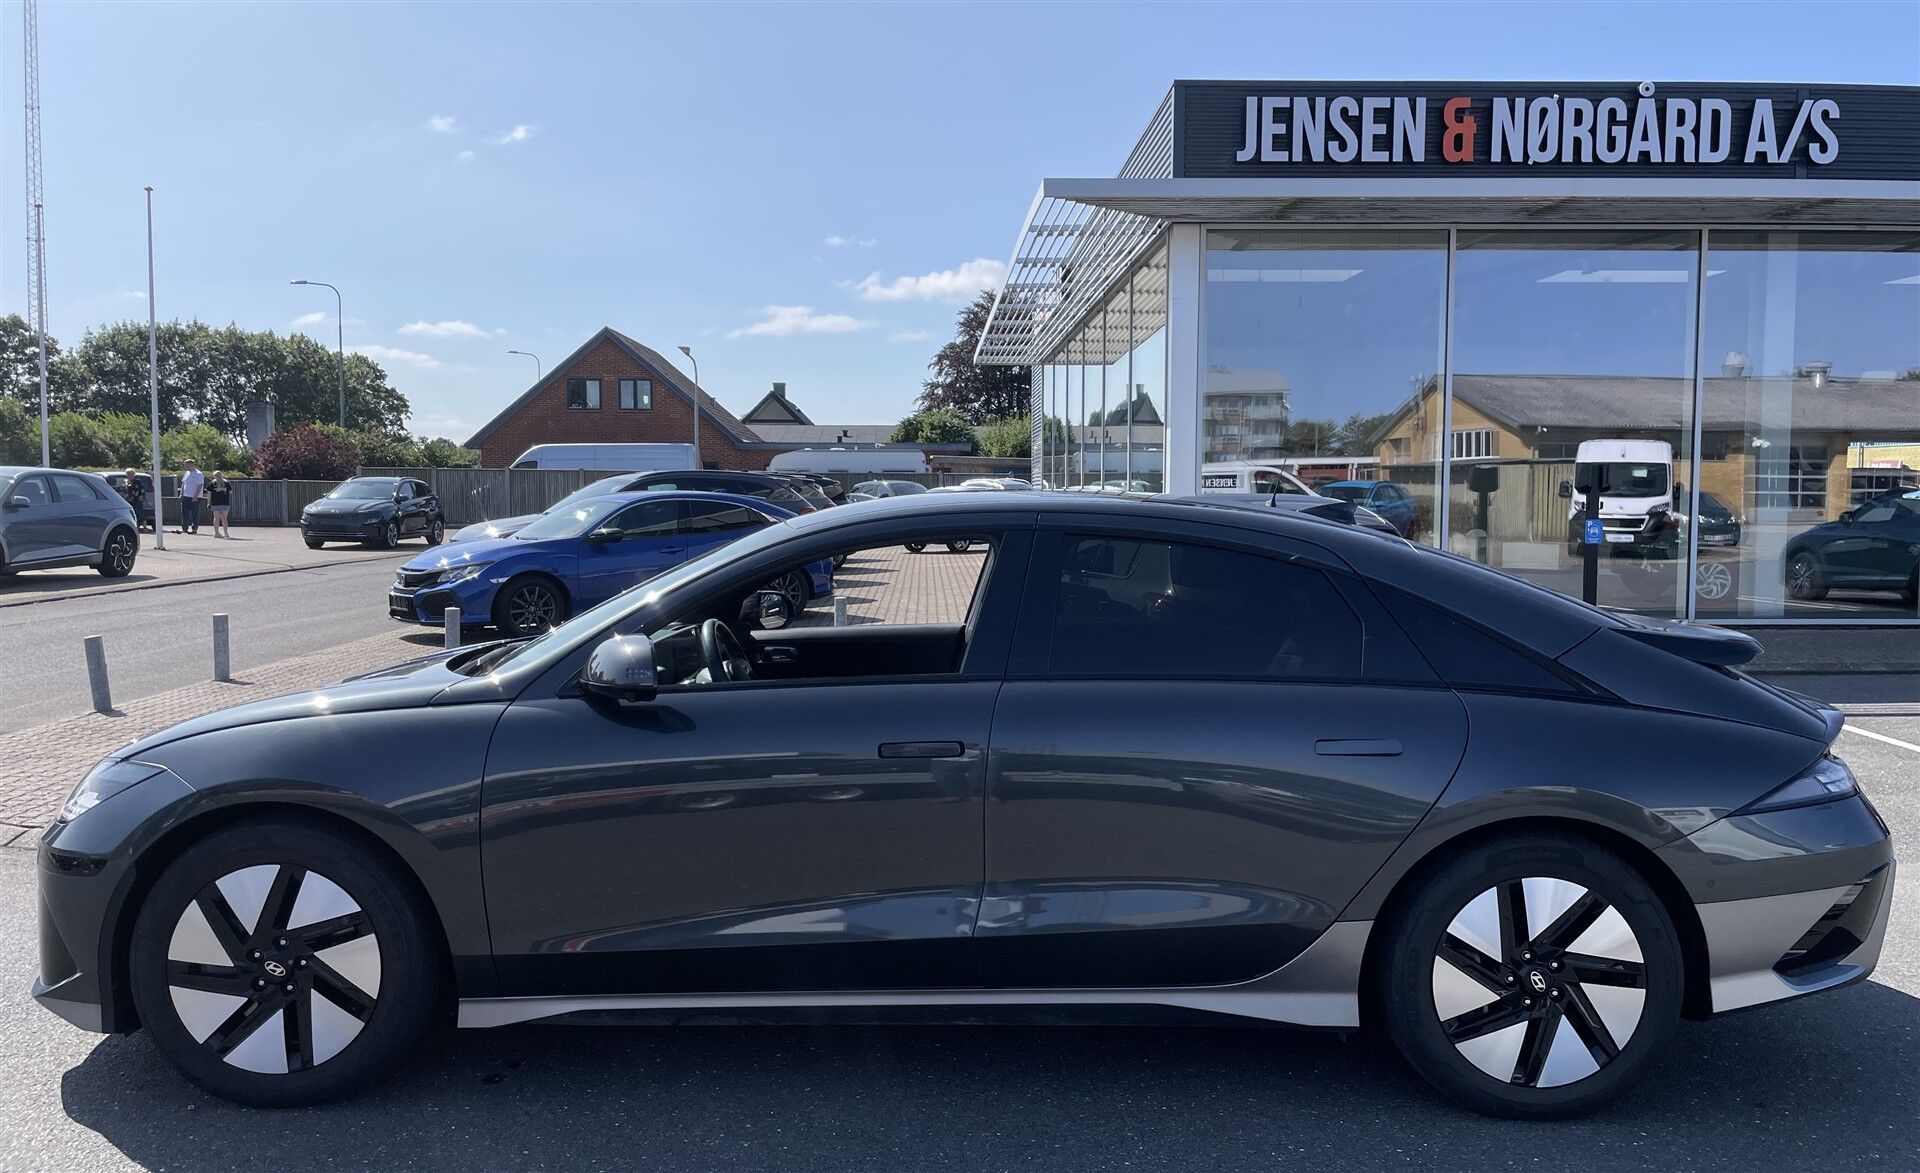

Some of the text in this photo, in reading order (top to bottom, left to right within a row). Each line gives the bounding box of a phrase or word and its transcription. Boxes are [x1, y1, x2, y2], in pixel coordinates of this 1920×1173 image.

[1237, 81, 1840, 165] JENSEN & NØRGÅRD A/S
[1587, 520, 1593, 528] P
